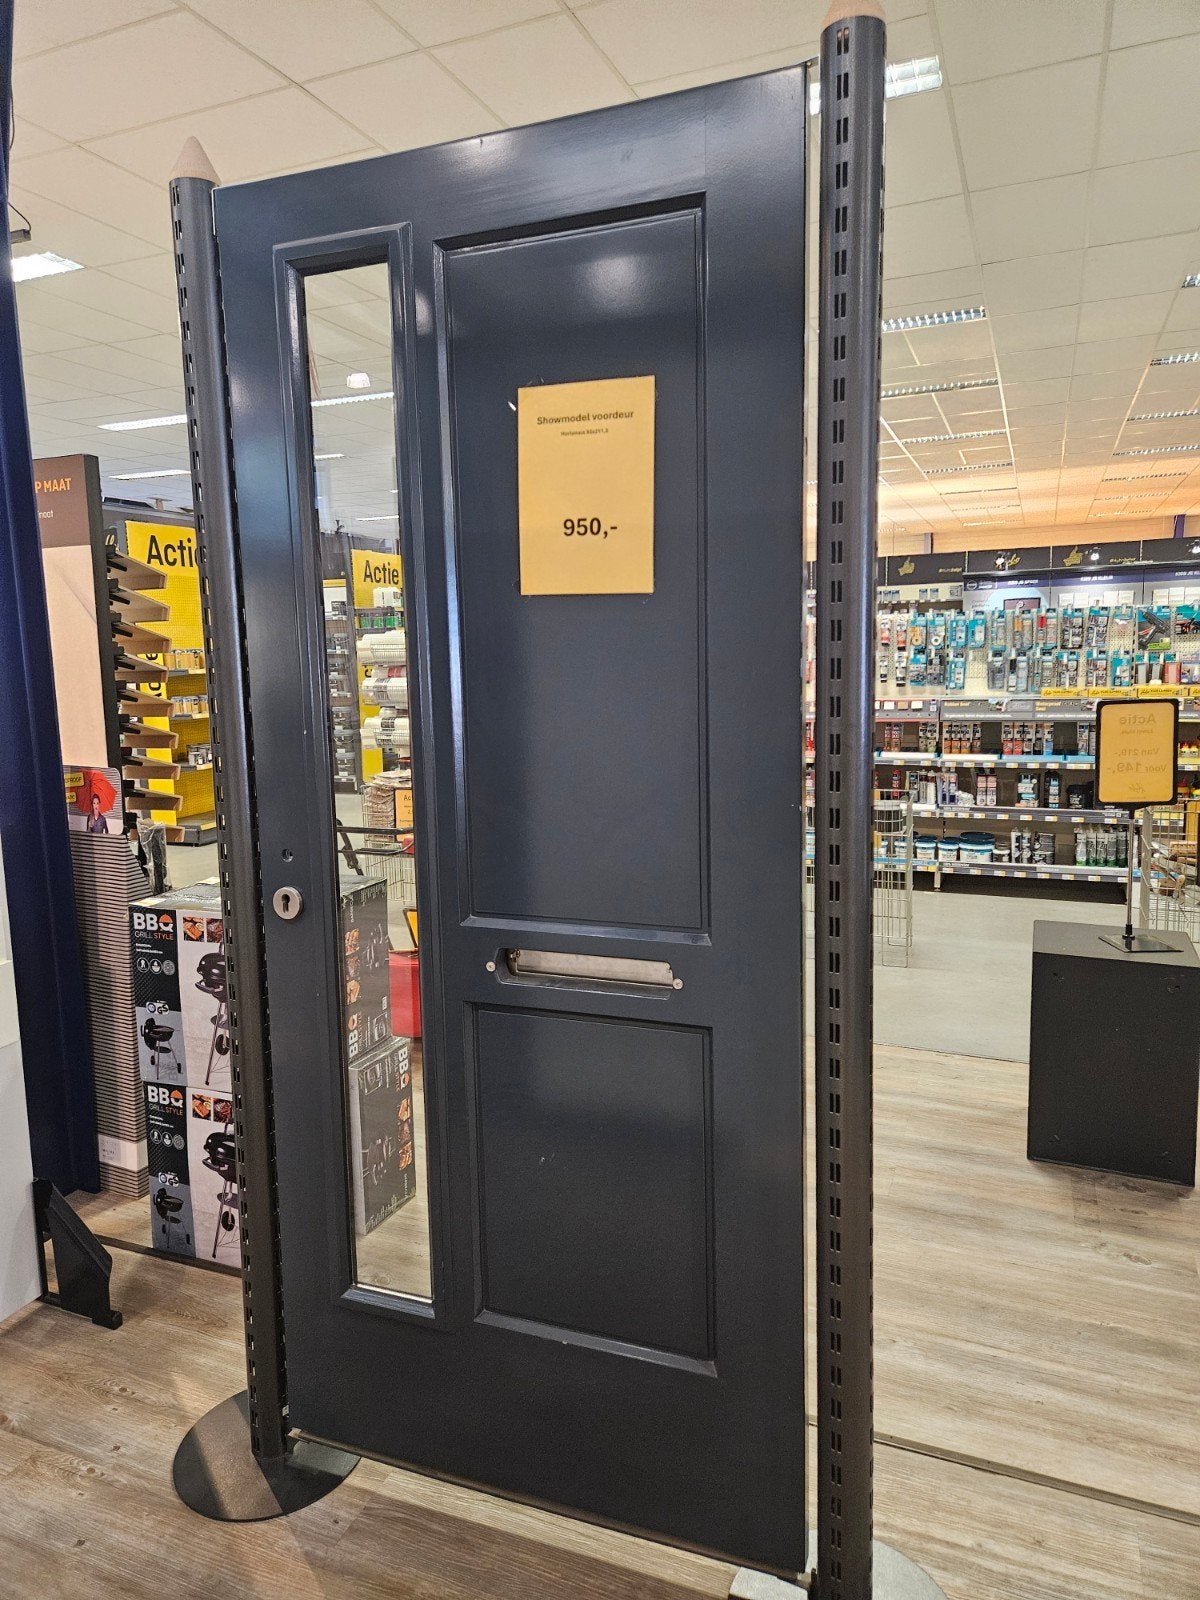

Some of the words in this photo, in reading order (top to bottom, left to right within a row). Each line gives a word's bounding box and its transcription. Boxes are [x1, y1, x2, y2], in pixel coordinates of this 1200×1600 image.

[537, 412, 590, 425] Showmodel
[592, 411, 634, 421] voordeur
[43, 478, 72, 492] MAAT
[563, 517, 618, 538] 950,-
[363, 559, 399, 585] Actie
[132, 912, 174, 932] BBQ
[134, 930, 153, 939] GRILL
[153, 932, 174, 941] STYLE
[348, 1012, 359, 1057] BBQ
[398, 1046, 410, 1090] BBQ
[147, 1085, 184, 1108] BBQ
[165, 1107, 184, 1117] STYLE
